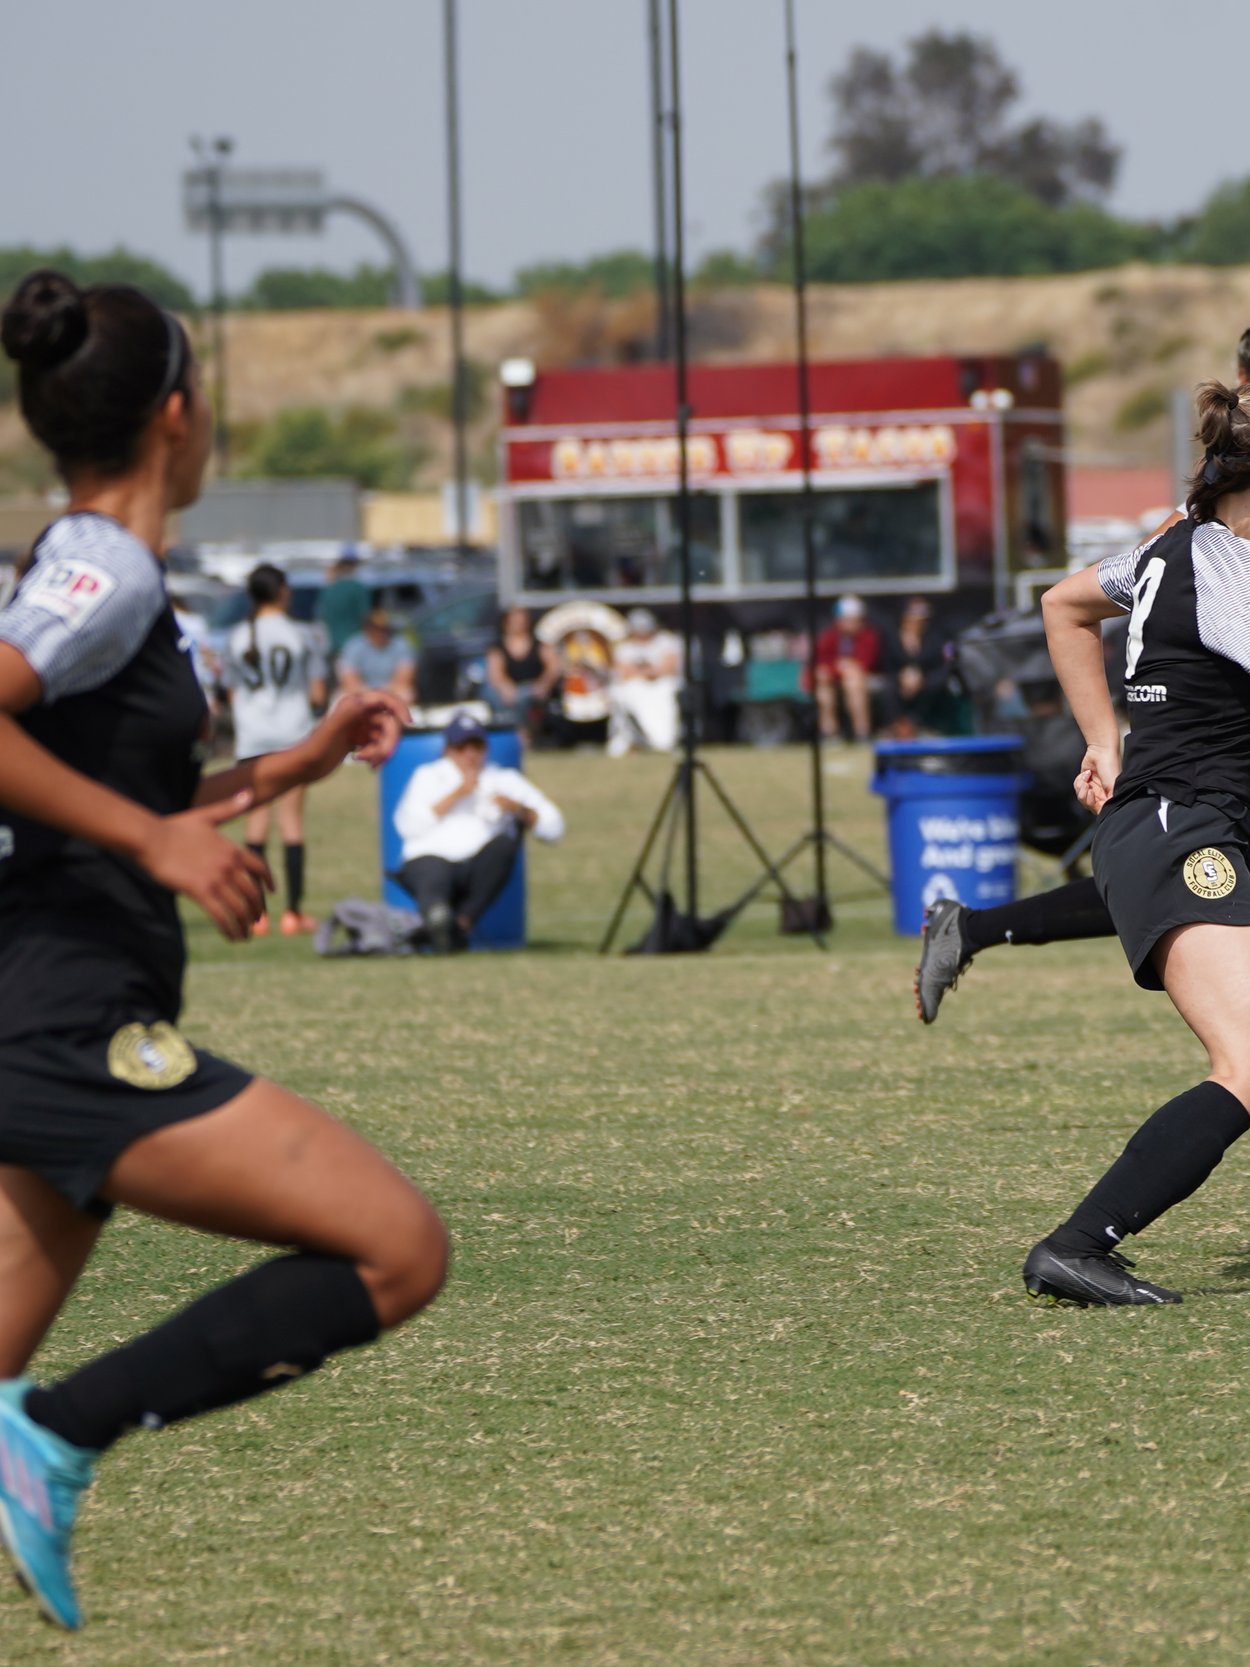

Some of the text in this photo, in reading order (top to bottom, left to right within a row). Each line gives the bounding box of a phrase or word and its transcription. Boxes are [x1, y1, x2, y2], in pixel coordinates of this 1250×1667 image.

[920, 841, 974, 870] And
[1187, 850, 1225, 867] SOCAL ELITE
[1189, 881, 1225, 897] FOOTBALL
[1225, 875, 1235, 891] CLUB
